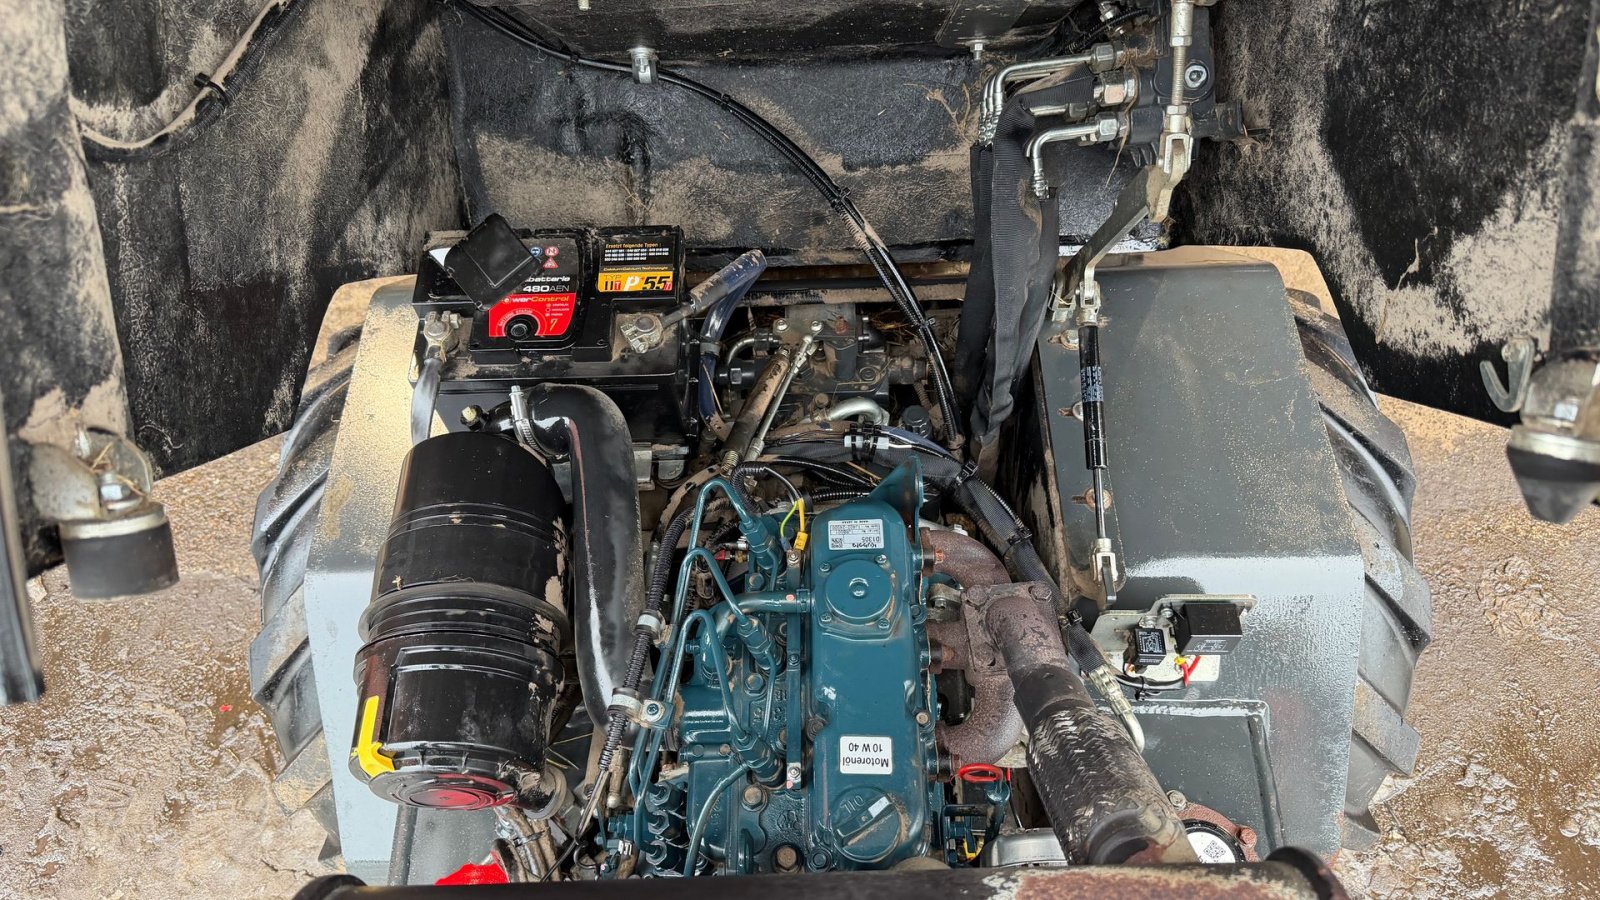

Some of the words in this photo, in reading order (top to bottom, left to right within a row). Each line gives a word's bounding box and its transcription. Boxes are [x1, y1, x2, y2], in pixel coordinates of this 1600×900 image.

[848, 742, 860, 752] 40
[862, 744, 870, 752] W
[872, 744, 882, 752] 10
[842, 756, 889, 768] Motorenöl
[840, 795, 864, 814] OIL
